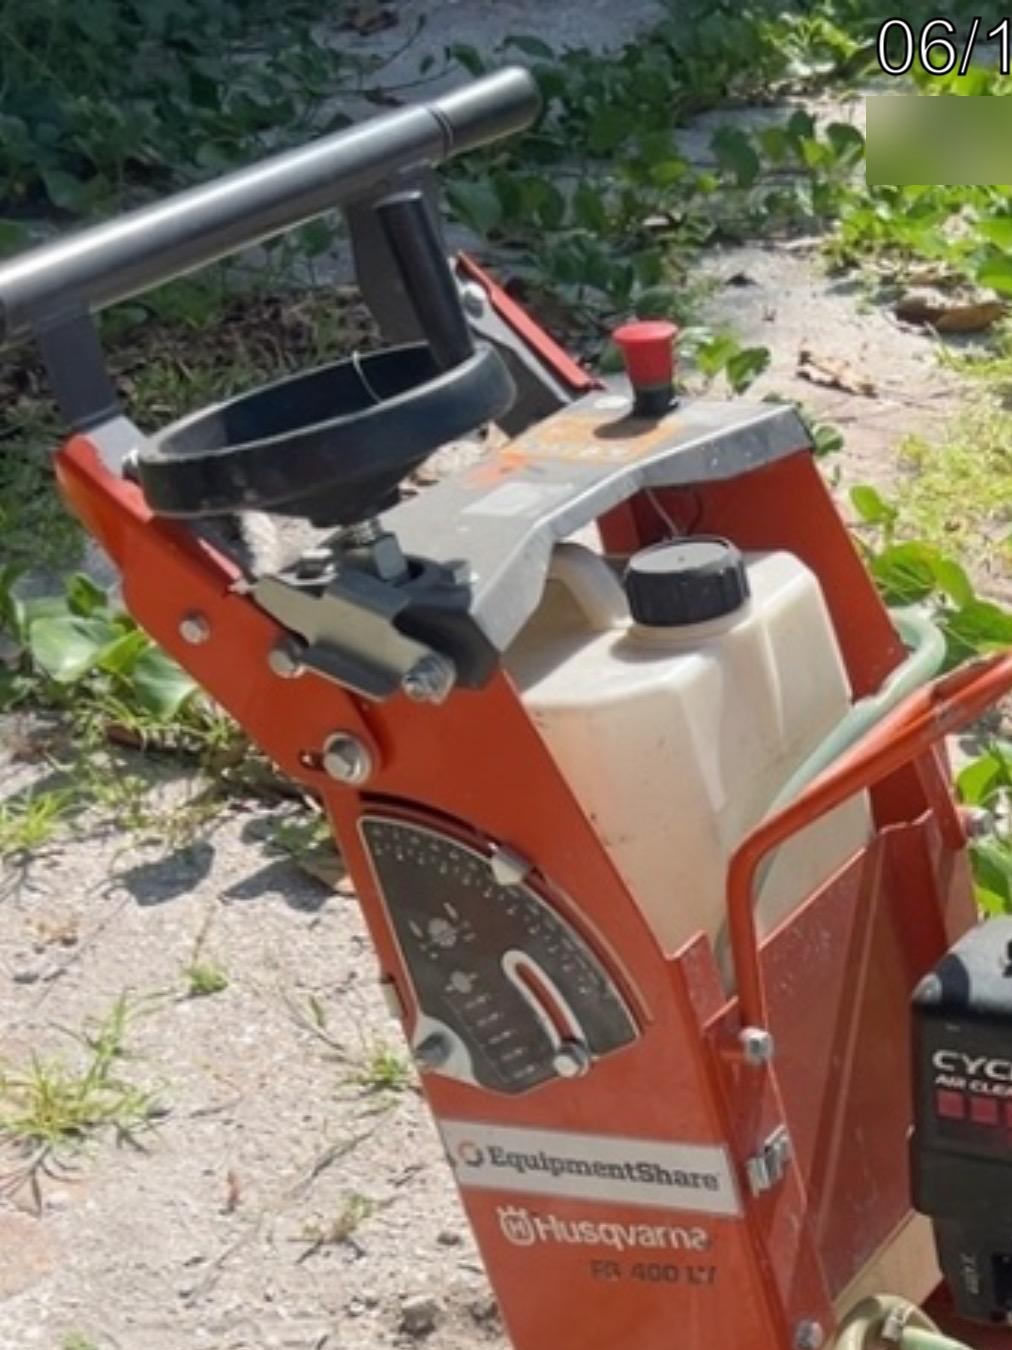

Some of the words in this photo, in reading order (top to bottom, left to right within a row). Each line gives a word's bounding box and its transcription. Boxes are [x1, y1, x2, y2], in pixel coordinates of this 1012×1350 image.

[486, 1146, 719, 1190] EquipmentShare
[535, 1214, 709, 1251] Husqvarna
[631, 1261, 679, 1283] 400
